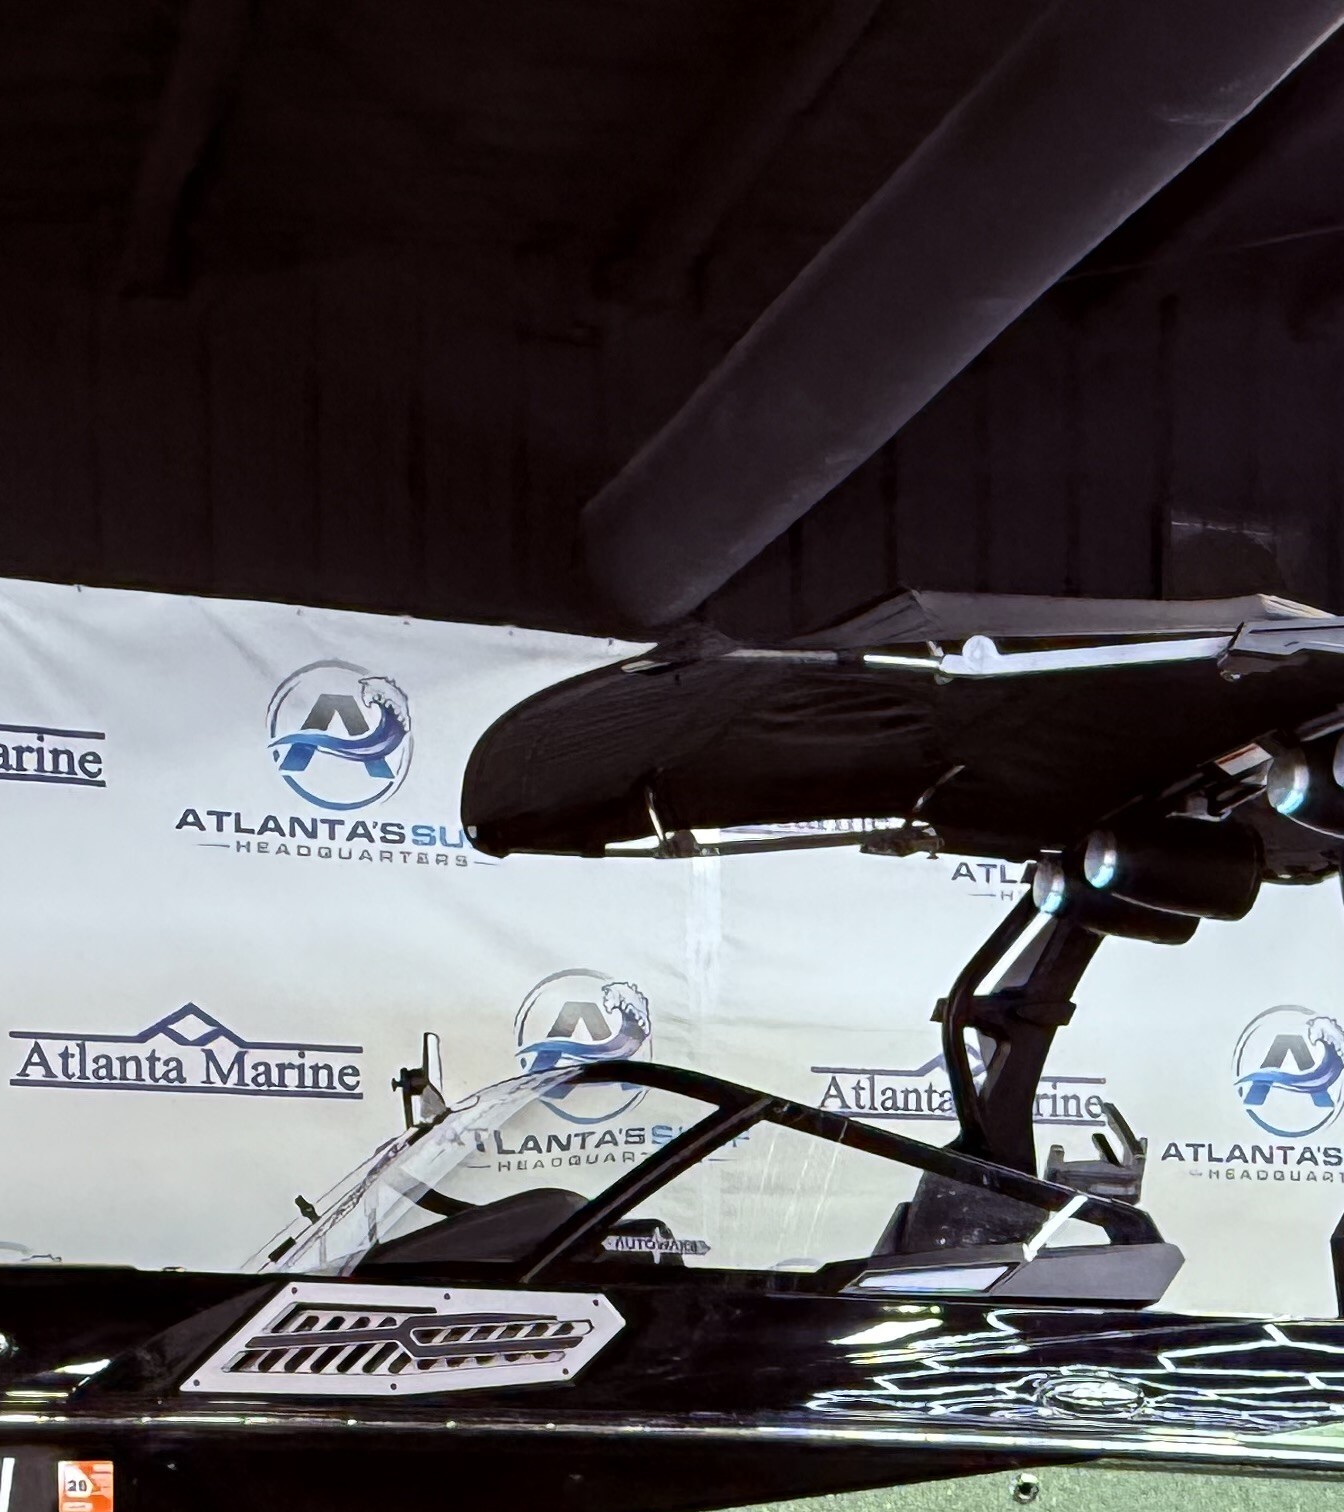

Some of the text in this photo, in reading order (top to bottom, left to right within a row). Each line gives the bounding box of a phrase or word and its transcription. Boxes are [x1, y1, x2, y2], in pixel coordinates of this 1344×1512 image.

[236, 840, 469, 867] HEADQUARTERS
[16, 1042, 361, 1092] Atlanta Marine
[1033, 1082, 1104, 1119] rine
